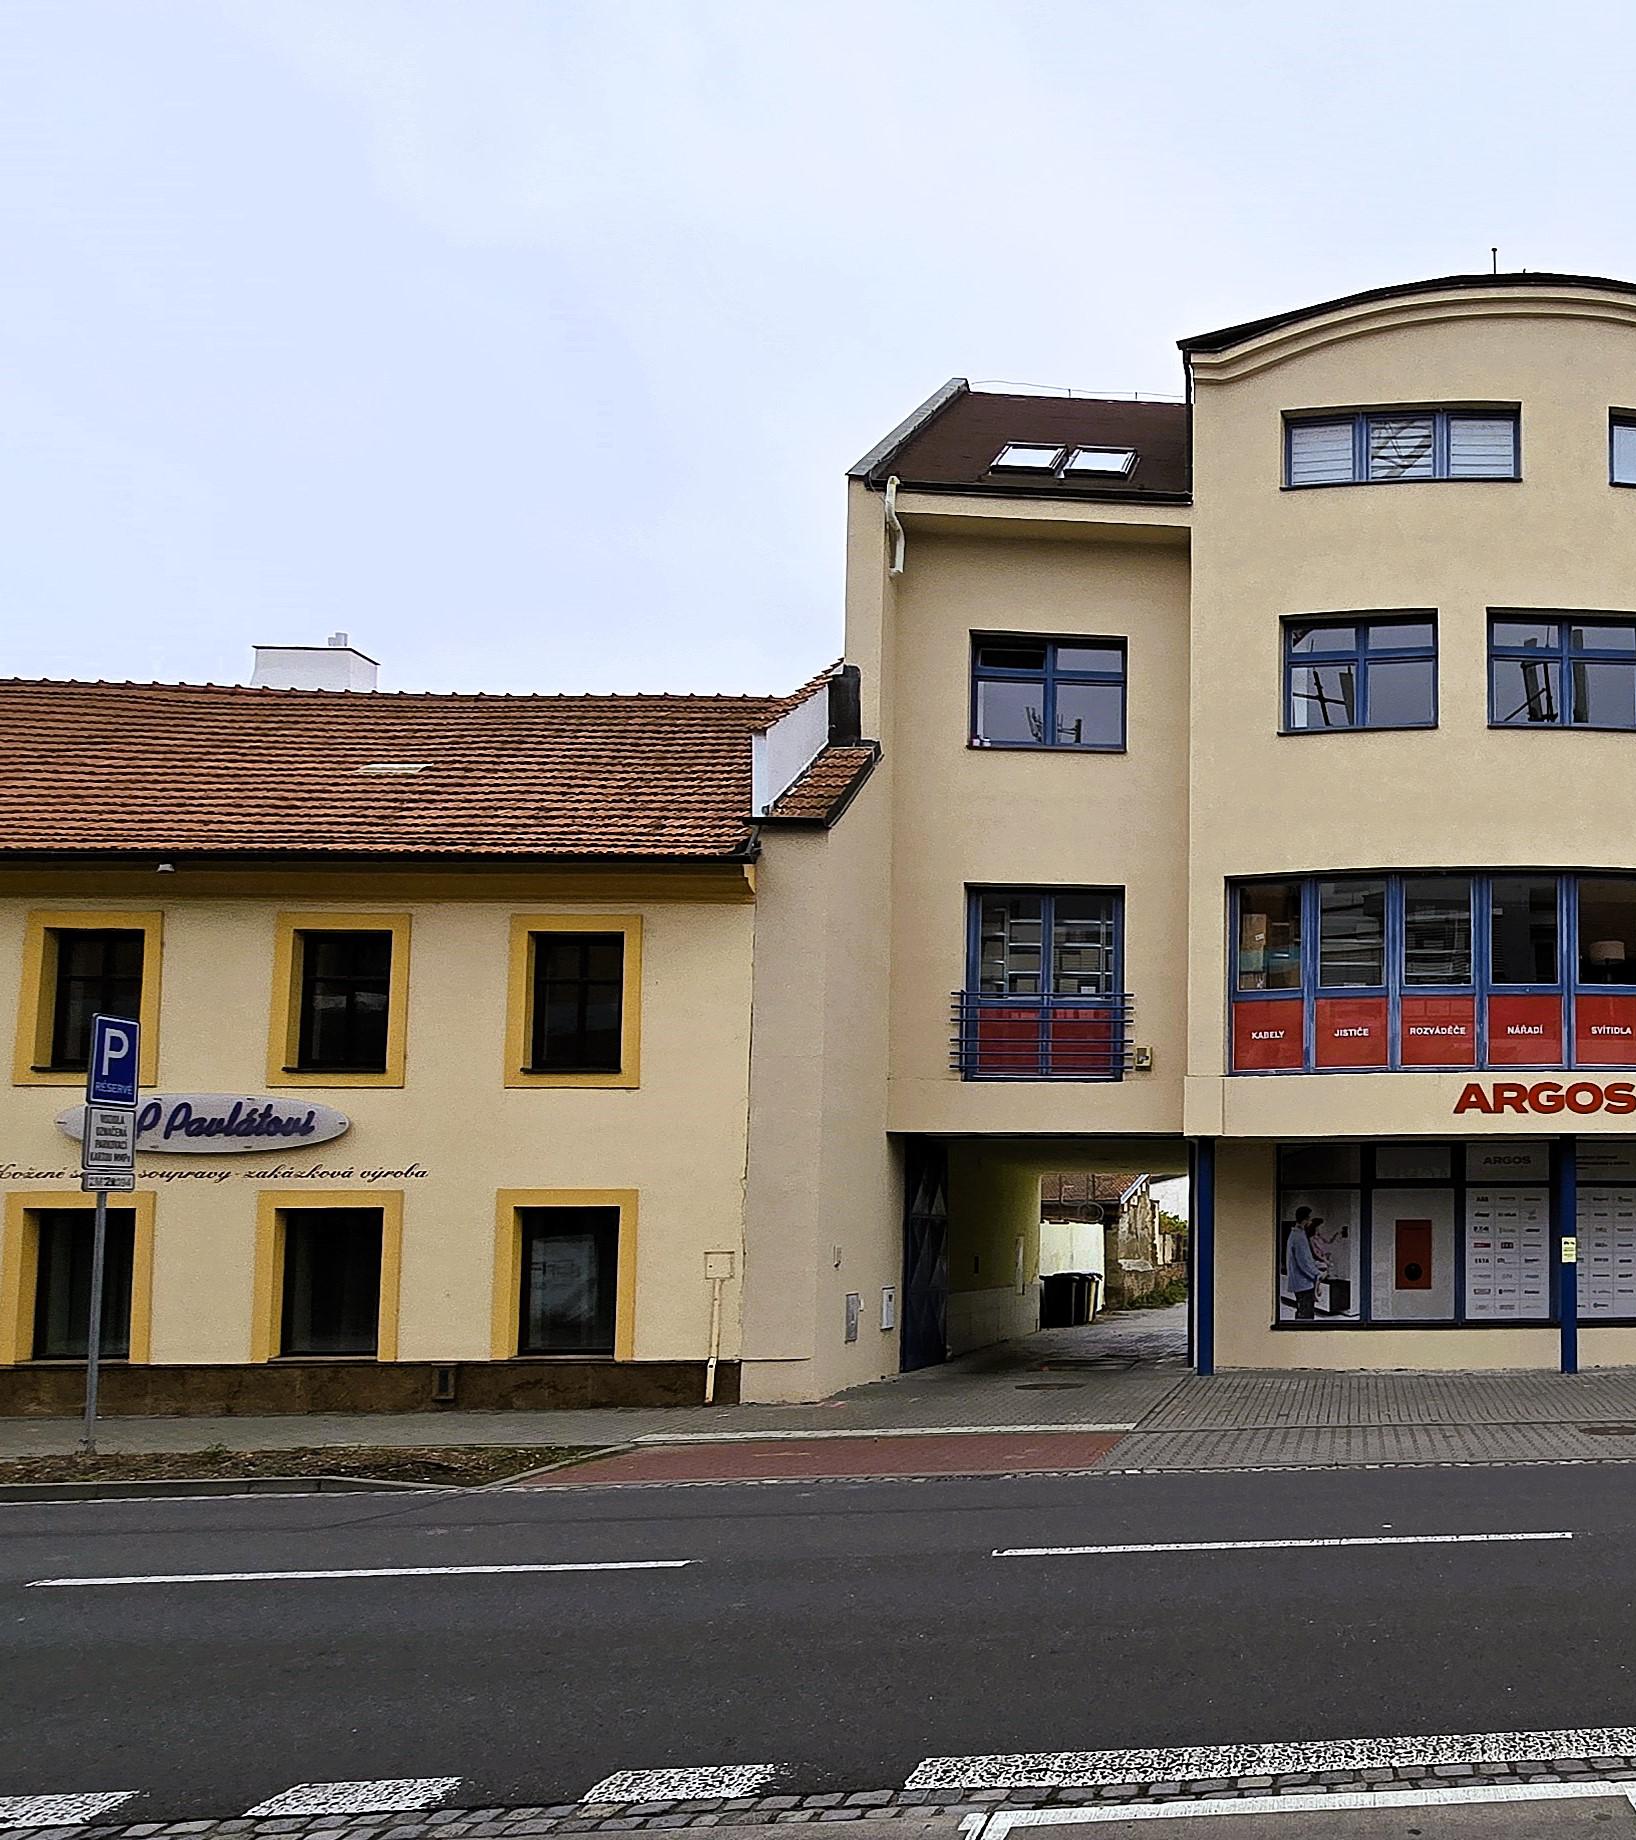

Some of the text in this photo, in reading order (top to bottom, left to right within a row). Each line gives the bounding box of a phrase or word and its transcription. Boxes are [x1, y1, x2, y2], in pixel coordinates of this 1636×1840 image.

[1334, 1027, 1369, 1037] JISTIČE
[1409, 1025, 1466, 1036] ROZVÁDĚČE
[1507, 1024, 1544, 1034] NÁŘADÍ
[1591, 1025, 1632, 1035] SVÍTIDLA
[1251, 1030, 1285, 1040] KABELY
[102, 1027, 129, 1076] P
[1483, 1156, 1531, 1165] ARGOS
[138, 1169, 231, 1184] soupravy
[243, 1163, 354, 1179] zakázková
[360, 1162, 429, 1183] výroba
